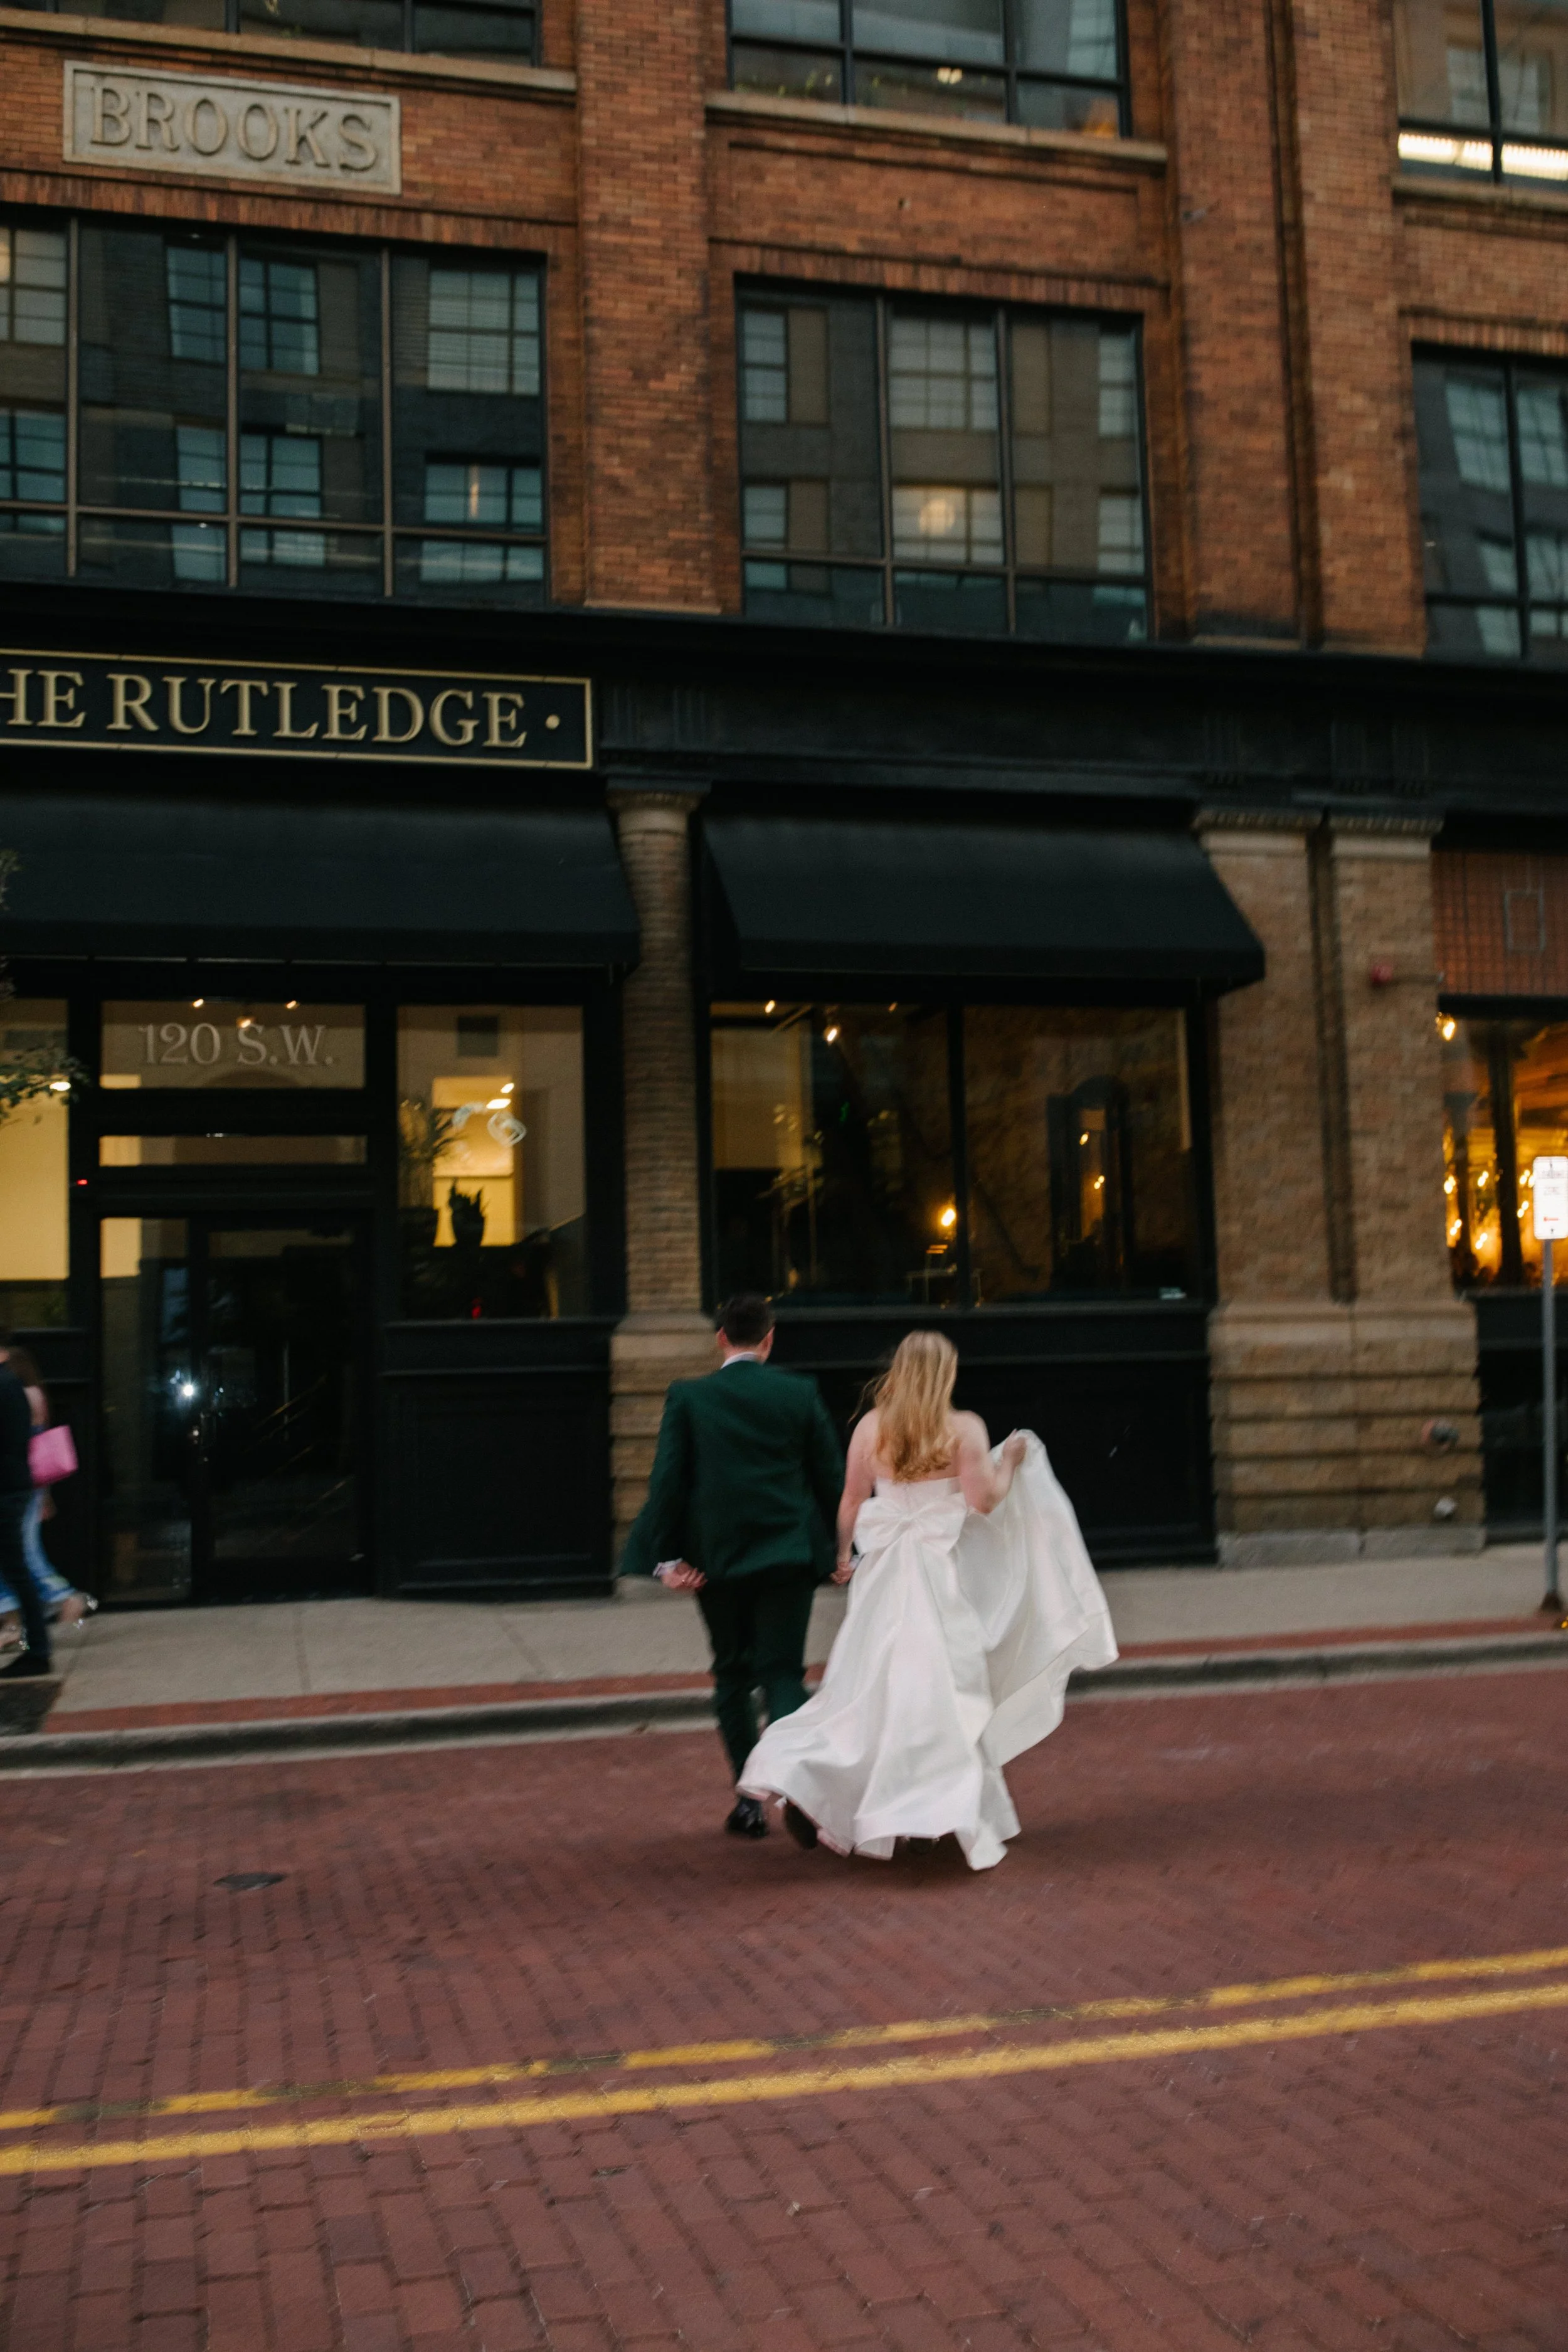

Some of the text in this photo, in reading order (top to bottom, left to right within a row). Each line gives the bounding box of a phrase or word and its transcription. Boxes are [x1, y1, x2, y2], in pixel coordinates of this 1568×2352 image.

[90, 85, 379, 172] BROOKS
[107, 673, 527, 748] RUTLEDGE
[137, 1022, 334, 1066] 120 S.W.
